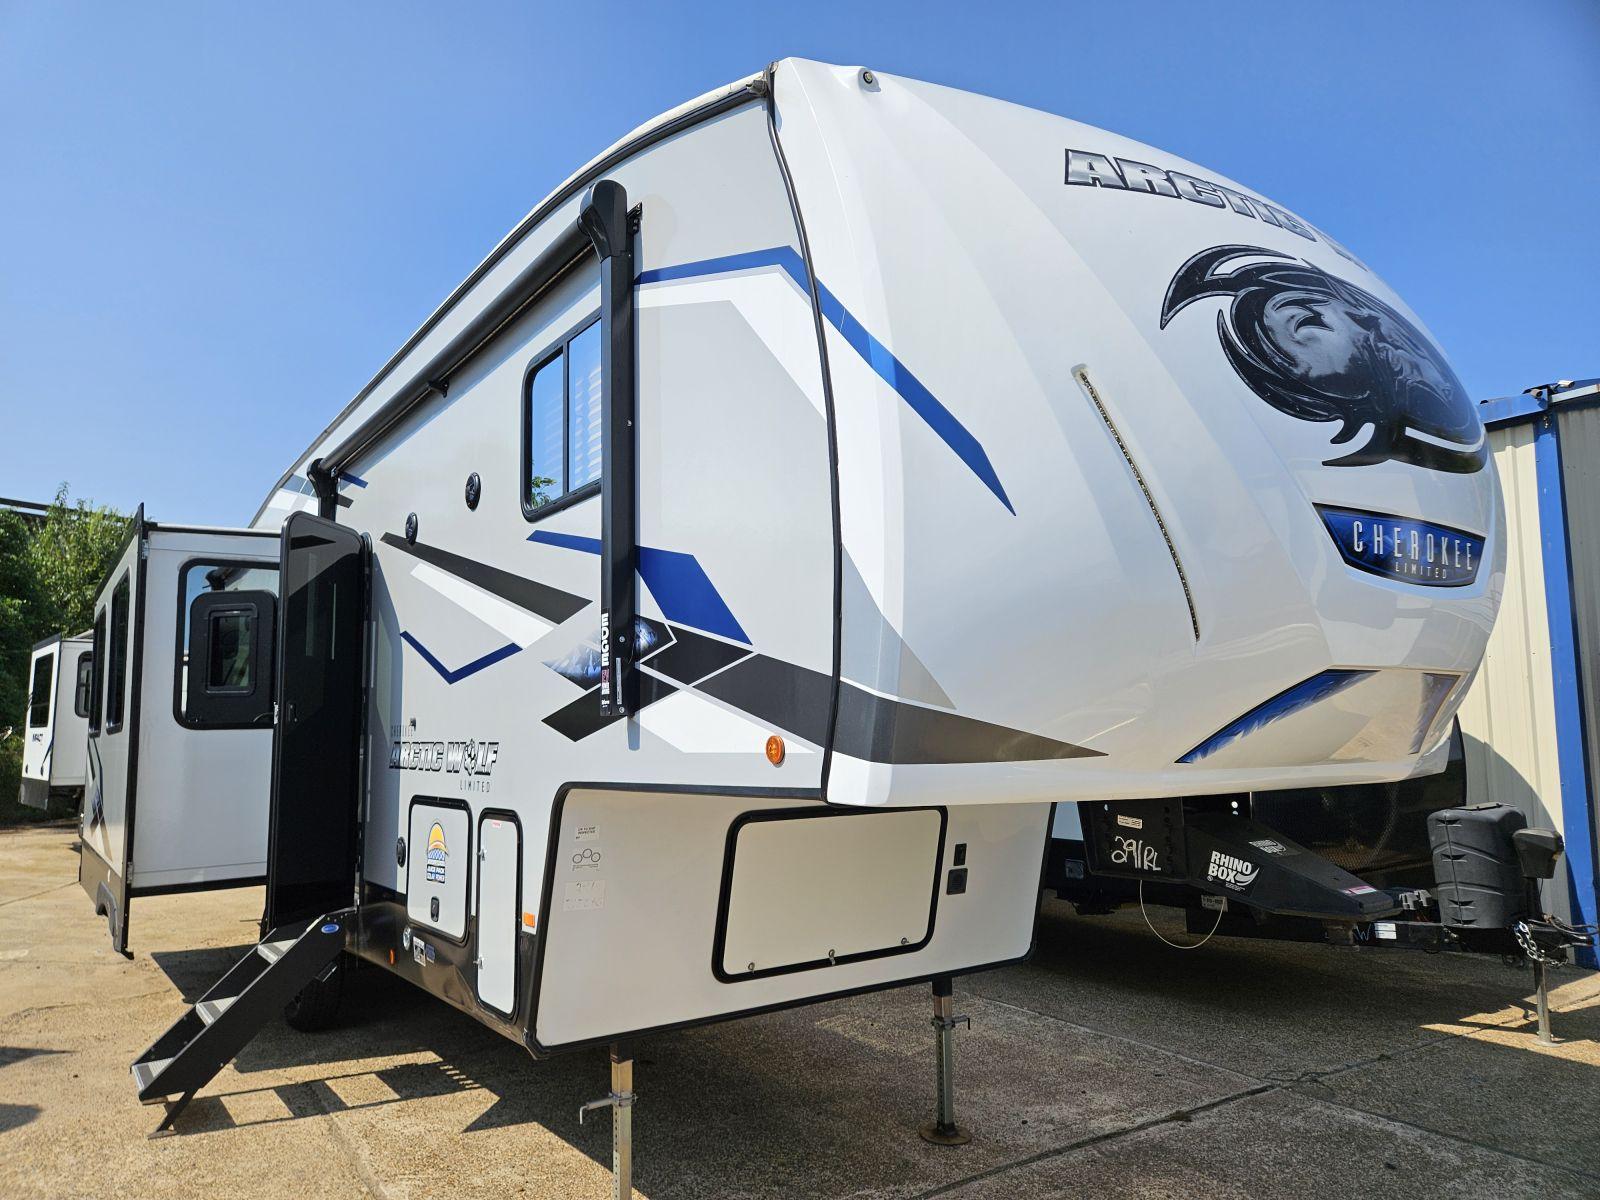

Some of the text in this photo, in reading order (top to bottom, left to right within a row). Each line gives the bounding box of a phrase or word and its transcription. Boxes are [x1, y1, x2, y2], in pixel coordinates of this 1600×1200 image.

[1065, 148, 1317, 242] ARCTIC
[1353, 520, 1473, 571] CHEROKEE
[1395, 561, 1447, 579] LIMITED
[389, 741, 444, 772] ARCTIC
[460, 779, 491, 793] LIMITED
[1208, 862, 1237, 883] BOX
[1211, 850, 1252, 875] RHINO
